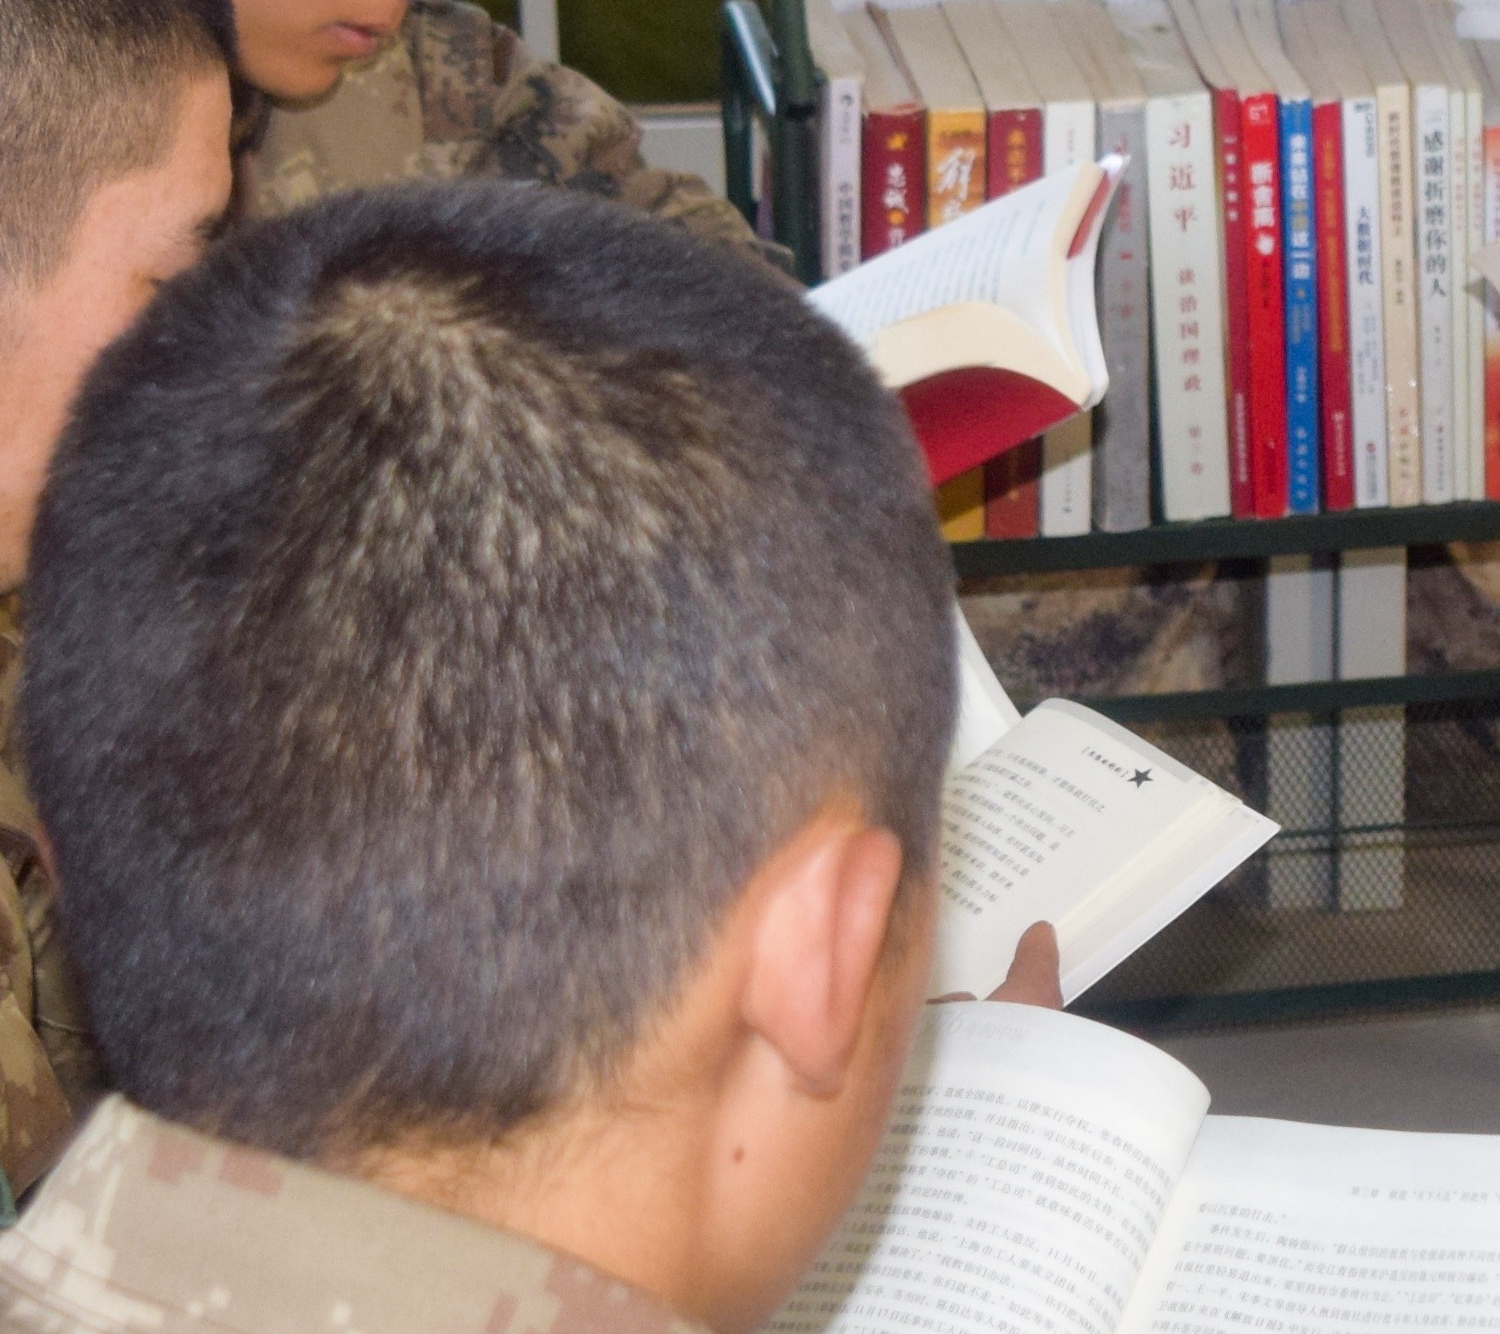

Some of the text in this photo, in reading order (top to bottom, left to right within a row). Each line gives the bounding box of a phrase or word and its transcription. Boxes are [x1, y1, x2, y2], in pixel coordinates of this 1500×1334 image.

[1167, 123, 1197, 231] 习近平
[1422, 130, 1448, 298] 感谢折磨你的人
[1355, 204, 1375, 285] 大数据时代
[1178, 269, 1202, 393] 谈治国理政
